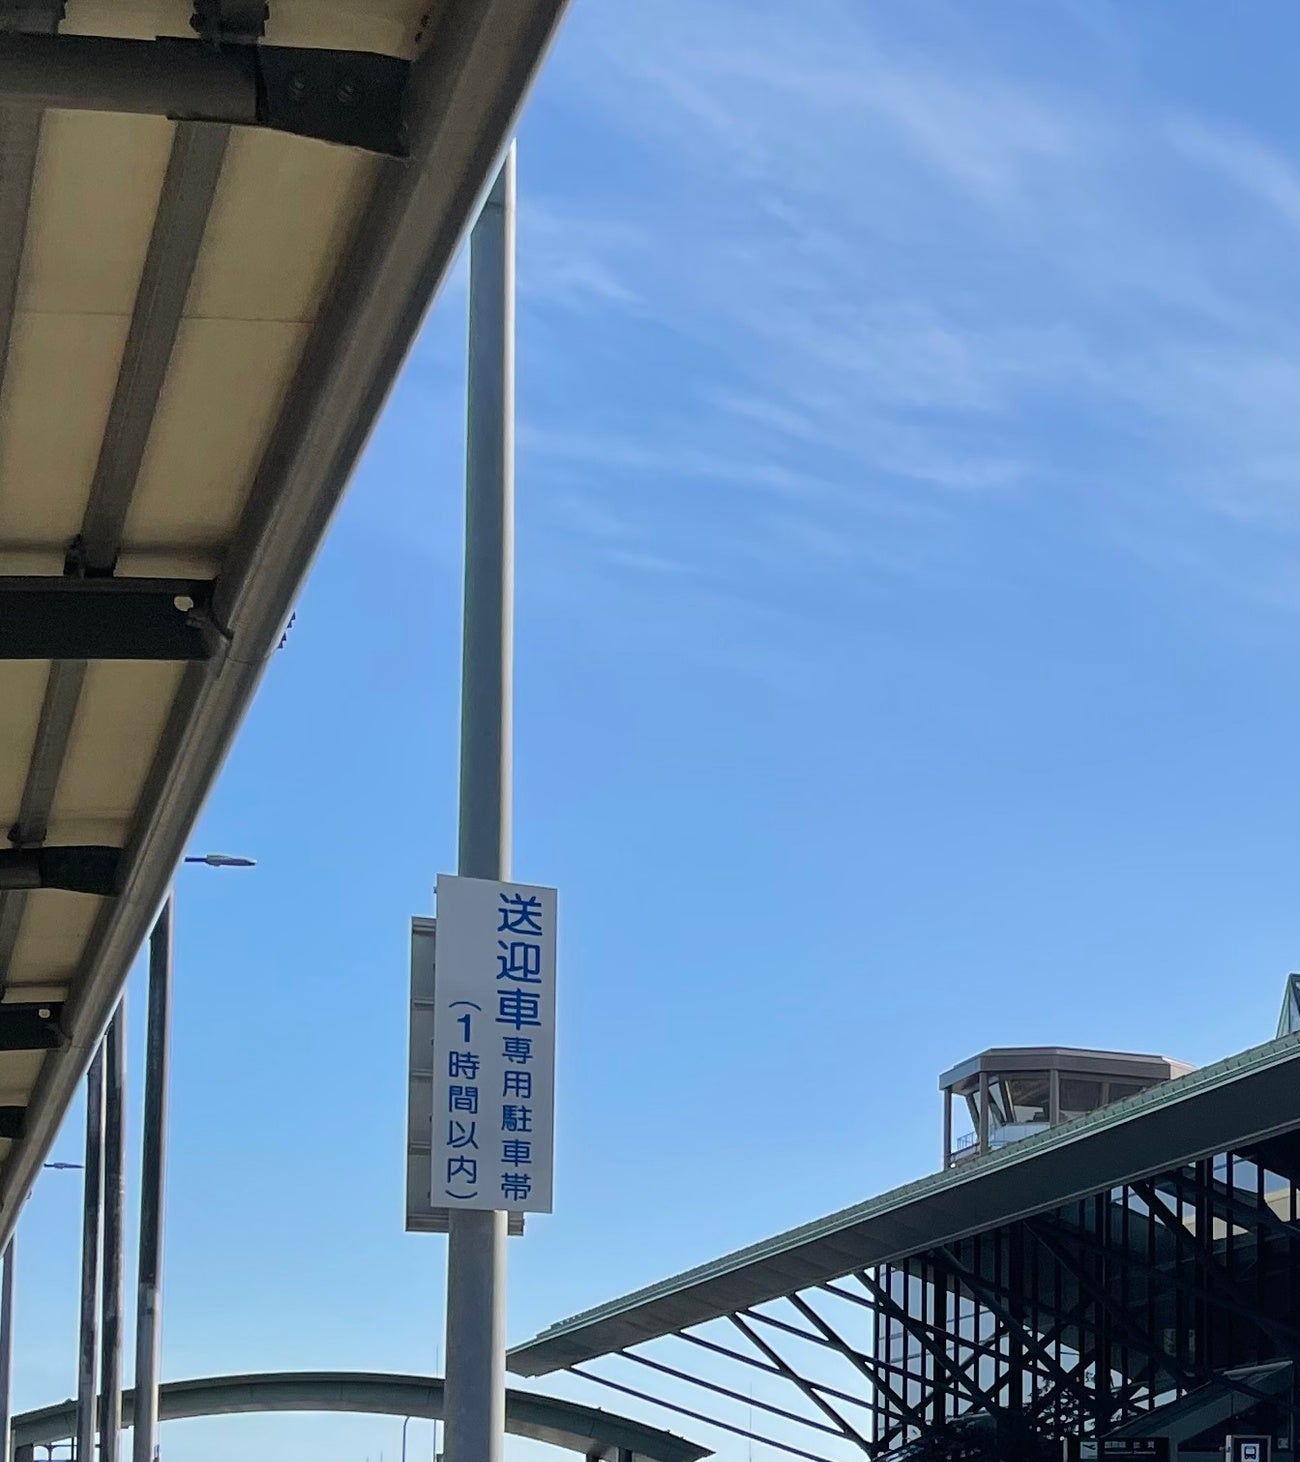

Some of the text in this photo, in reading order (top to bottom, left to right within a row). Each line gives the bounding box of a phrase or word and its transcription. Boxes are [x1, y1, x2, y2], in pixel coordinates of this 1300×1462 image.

[495, 893, 543, 1202] 送迎車専用駐車帯
